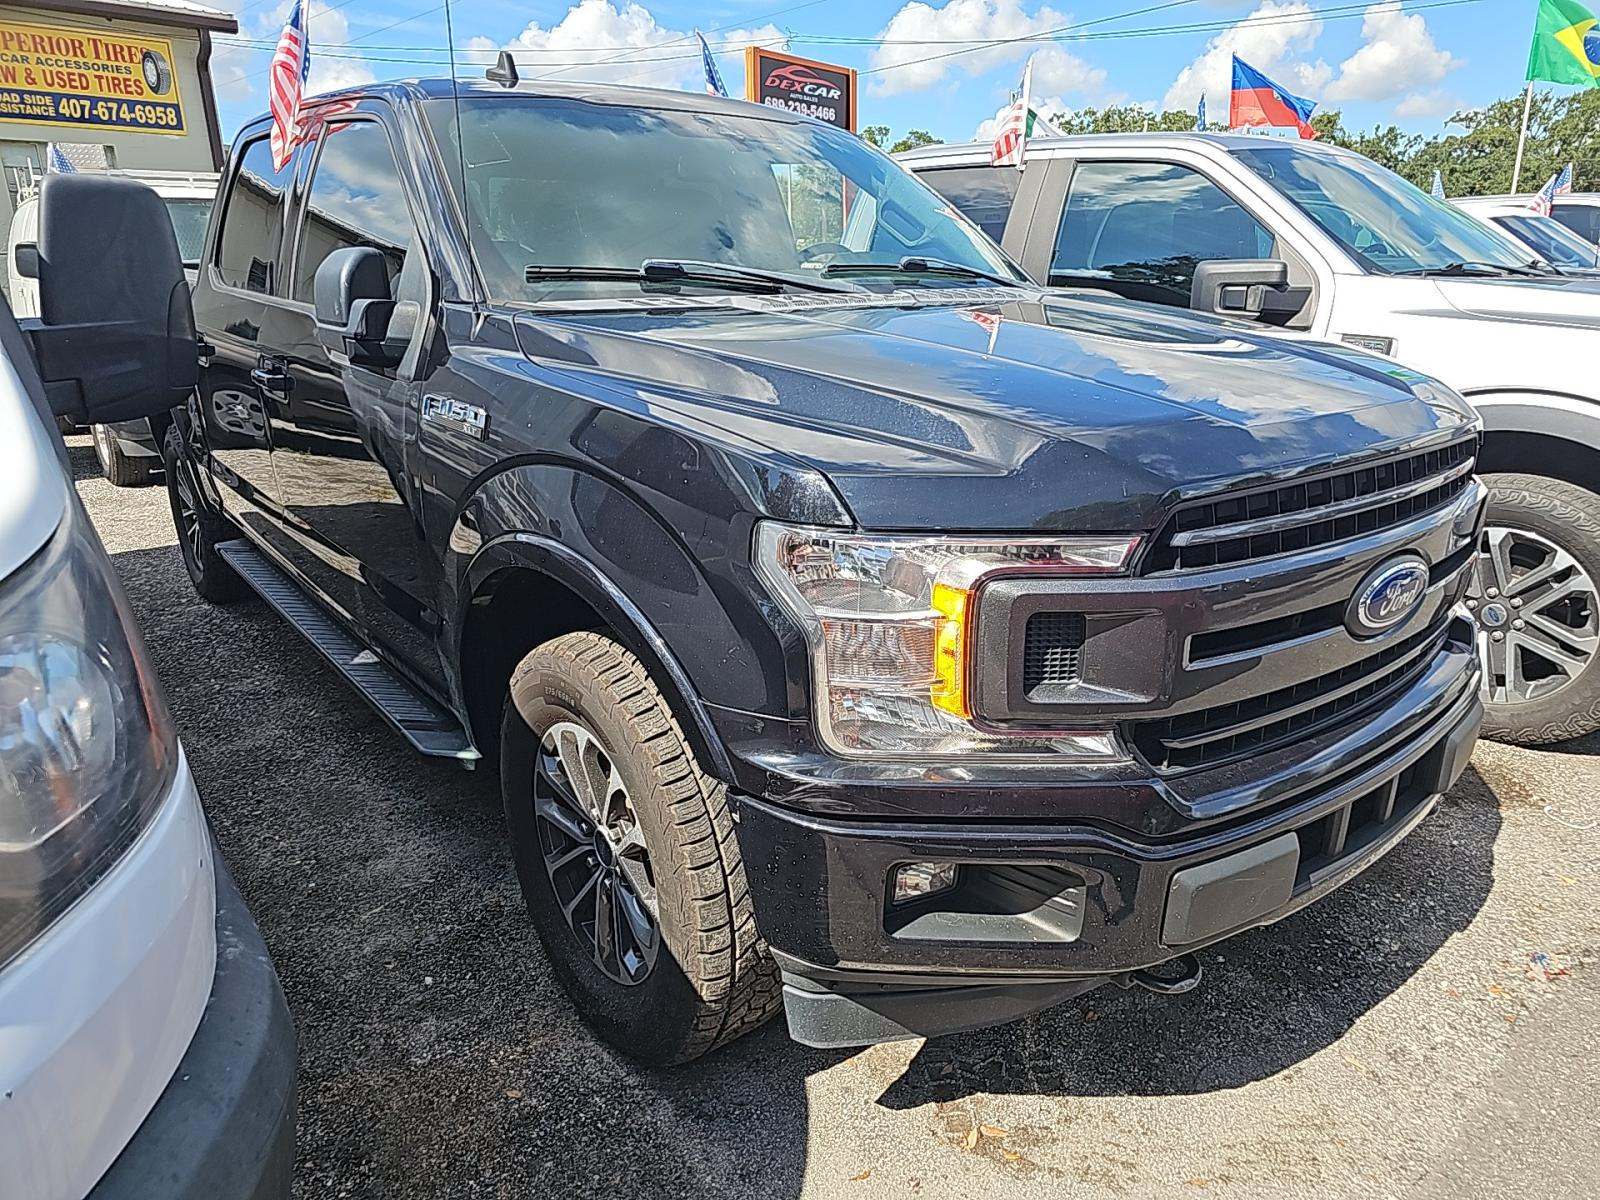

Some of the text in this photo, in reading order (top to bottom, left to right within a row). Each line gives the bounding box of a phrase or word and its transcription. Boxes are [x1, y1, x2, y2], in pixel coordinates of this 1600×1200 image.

[0, 53, 132, 75] CAR ACCESSORIES
[25, 67, 37, 85] &
[42, 69, 90, 91] USED
[94, 74, 144, 97] TIRES
[764, 77, 841, 99] DEXCAR
[23, 94, 54, 106] SIDE
[59, 97, 178, 126] 407-674-6958
[1380, 577, 1419, 616] Ford
